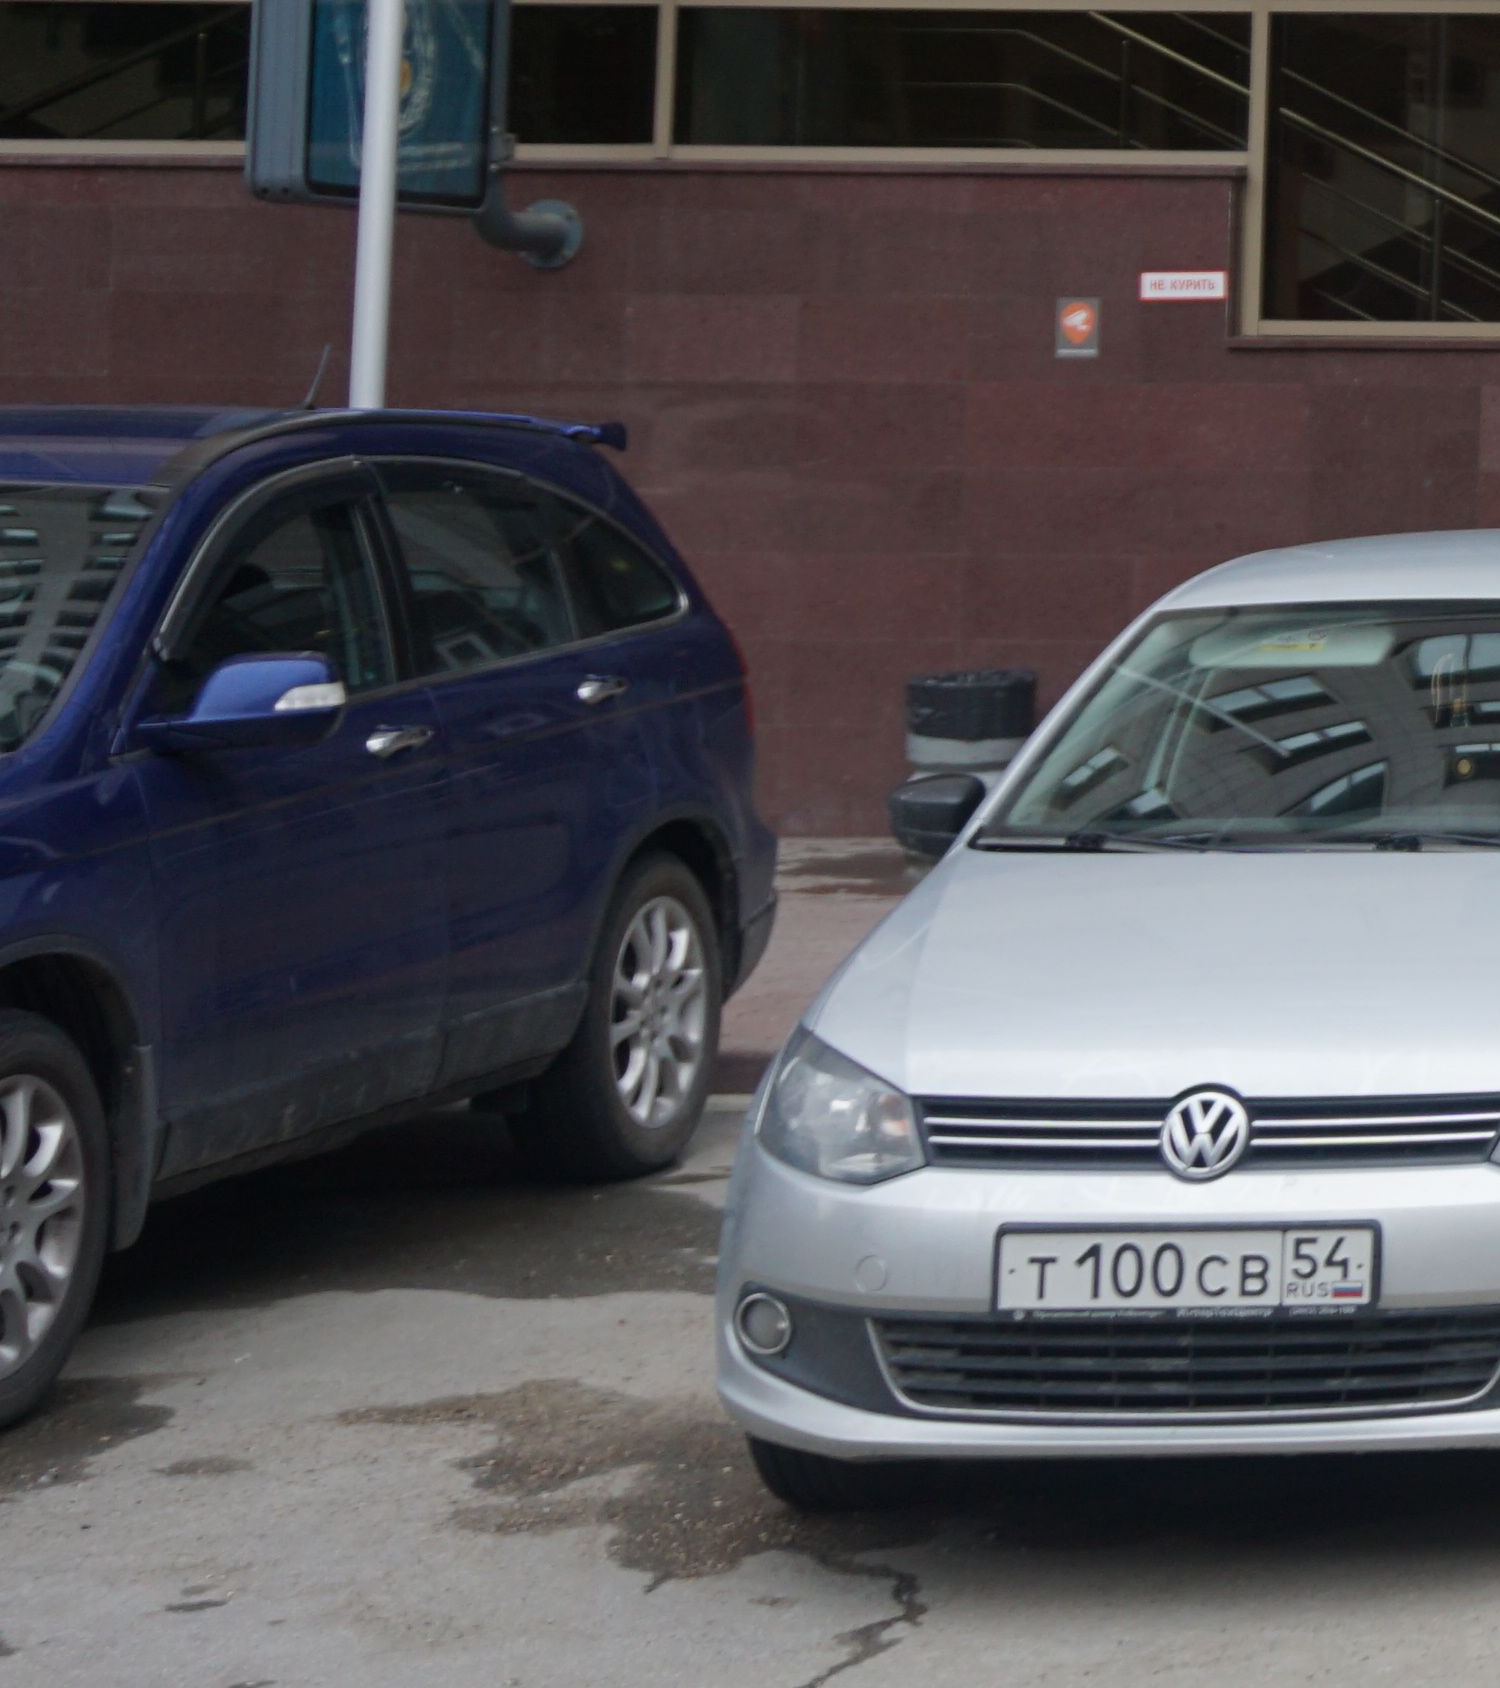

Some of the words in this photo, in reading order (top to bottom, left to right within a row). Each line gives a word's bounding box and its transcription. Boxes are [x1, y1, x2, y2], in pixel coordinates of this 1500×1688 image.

[1149, 279, 1165, 291] НЕ
[1170, 278, 1216, 291] КУРИТЬ
[1291, 1236, 1351, 1280] 54
[1286, 1282, 1329, 1299] RUS
